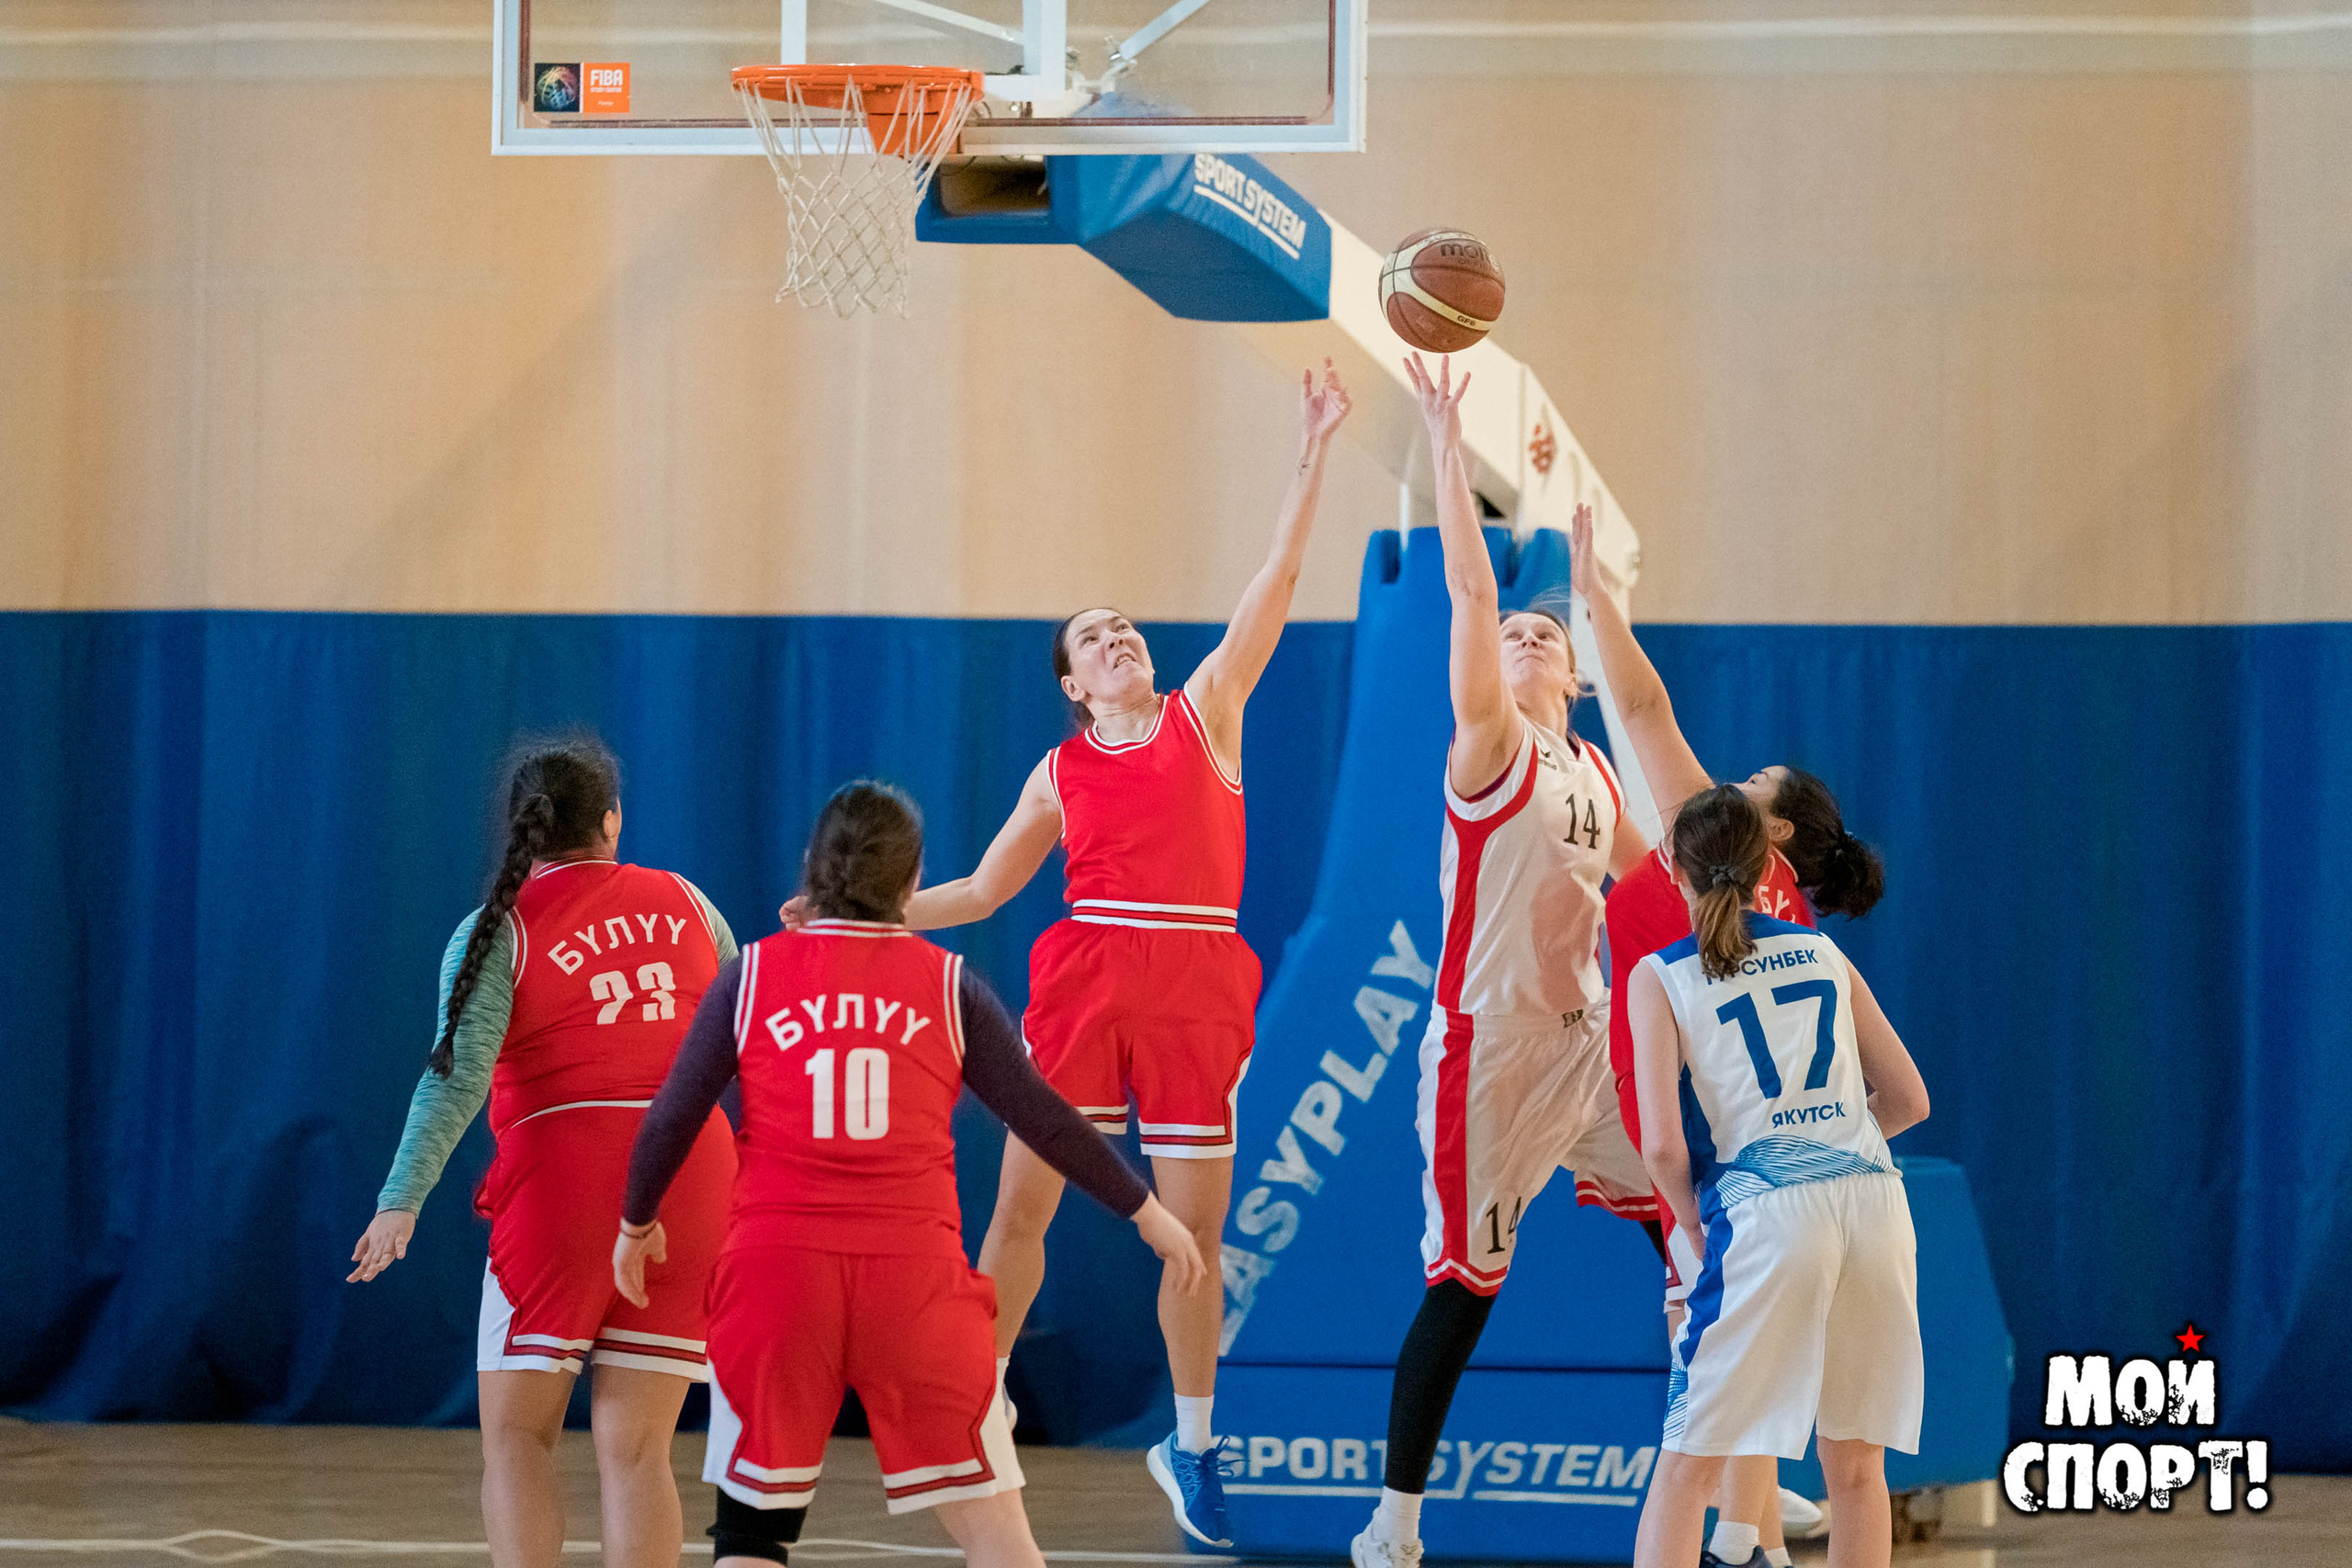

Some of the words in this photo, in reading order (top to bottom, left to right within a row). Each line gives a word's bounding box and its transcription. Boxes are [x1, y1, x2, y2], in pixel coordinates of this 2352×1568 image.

[590, 69, 623, 86] FIBA
[1194, 153, 1246, 203] SPORT
[1244, 179, 1306, 249] SYSTEM
[1456, 314, 1476, 326] GF6
[1564, 793, 1600, 850] 14
[588, 961, 676, 1025] 23
[1706, 949, 1818, 986] СУНБЕК
[1715, 979, 1838, 1100] 17
[805, 1047, 889, 1140] 10
[1771, 1101, 1846, 1129] ЯКУТСК
